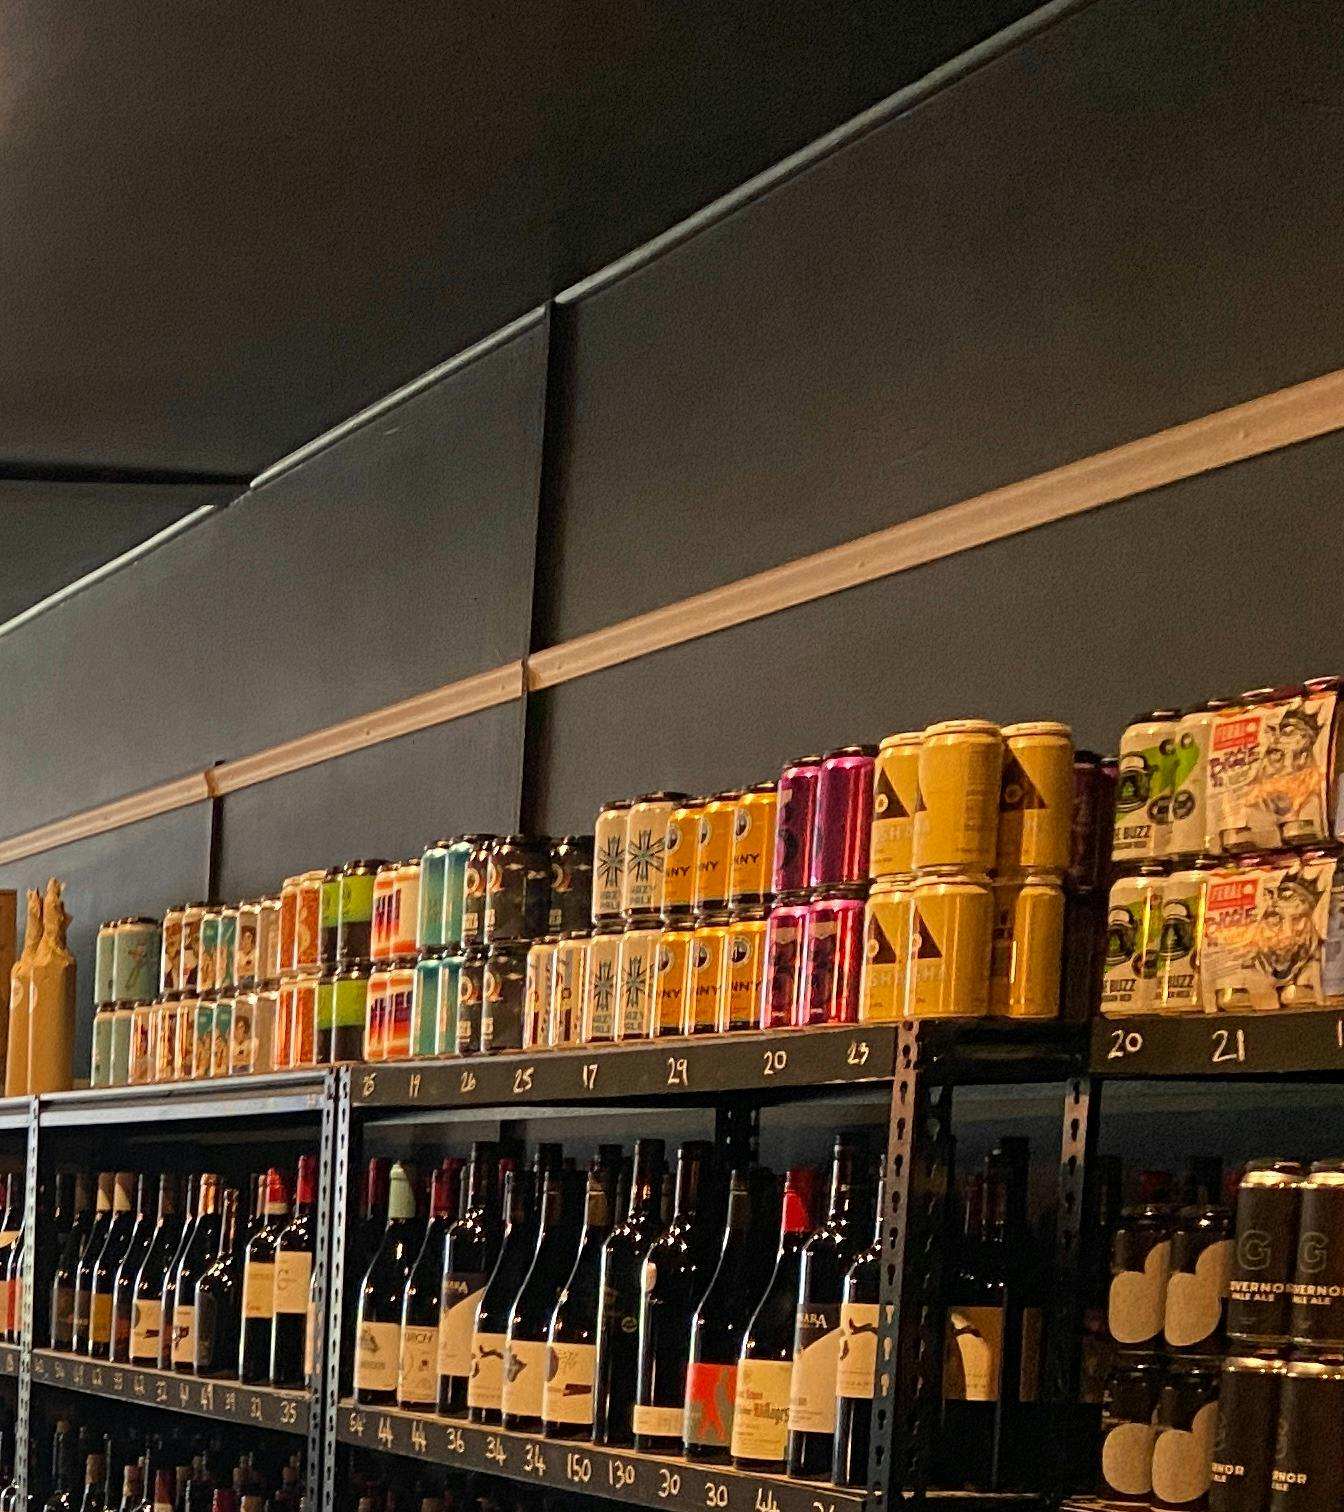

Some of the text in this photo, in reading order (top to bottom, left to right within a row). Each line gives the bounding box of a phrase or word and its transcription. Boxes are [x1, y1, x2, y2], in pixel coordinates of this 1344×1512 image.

[1108, 1030, 1143, 1059] 20
[1212, 1029, 1245, 1062] 21
[667, 1057, 688, 1086] 29
[763, 1050, 787, 1075] 20
[513, 1067, 533, 1093] 25
[582, 1065, 598, 1090] 17
[797, 1312, 828, 1330] ARA
[280, 1401, 297, 1424] 35
[377, 1417, 394, 1449] 44
[411, 1420, 428, 1454] 44
[446, 1428, 465, 1453] 36
[486, 1436, 507, 1467] 34
[523, 1444, 546, 1476] 34
[566, 1453, 592, 1483] 150
[608, 1459, 636, 1489] 130
[658, 1468, 681, 1498] 30
[705, 1482, 729, 1508] 30
